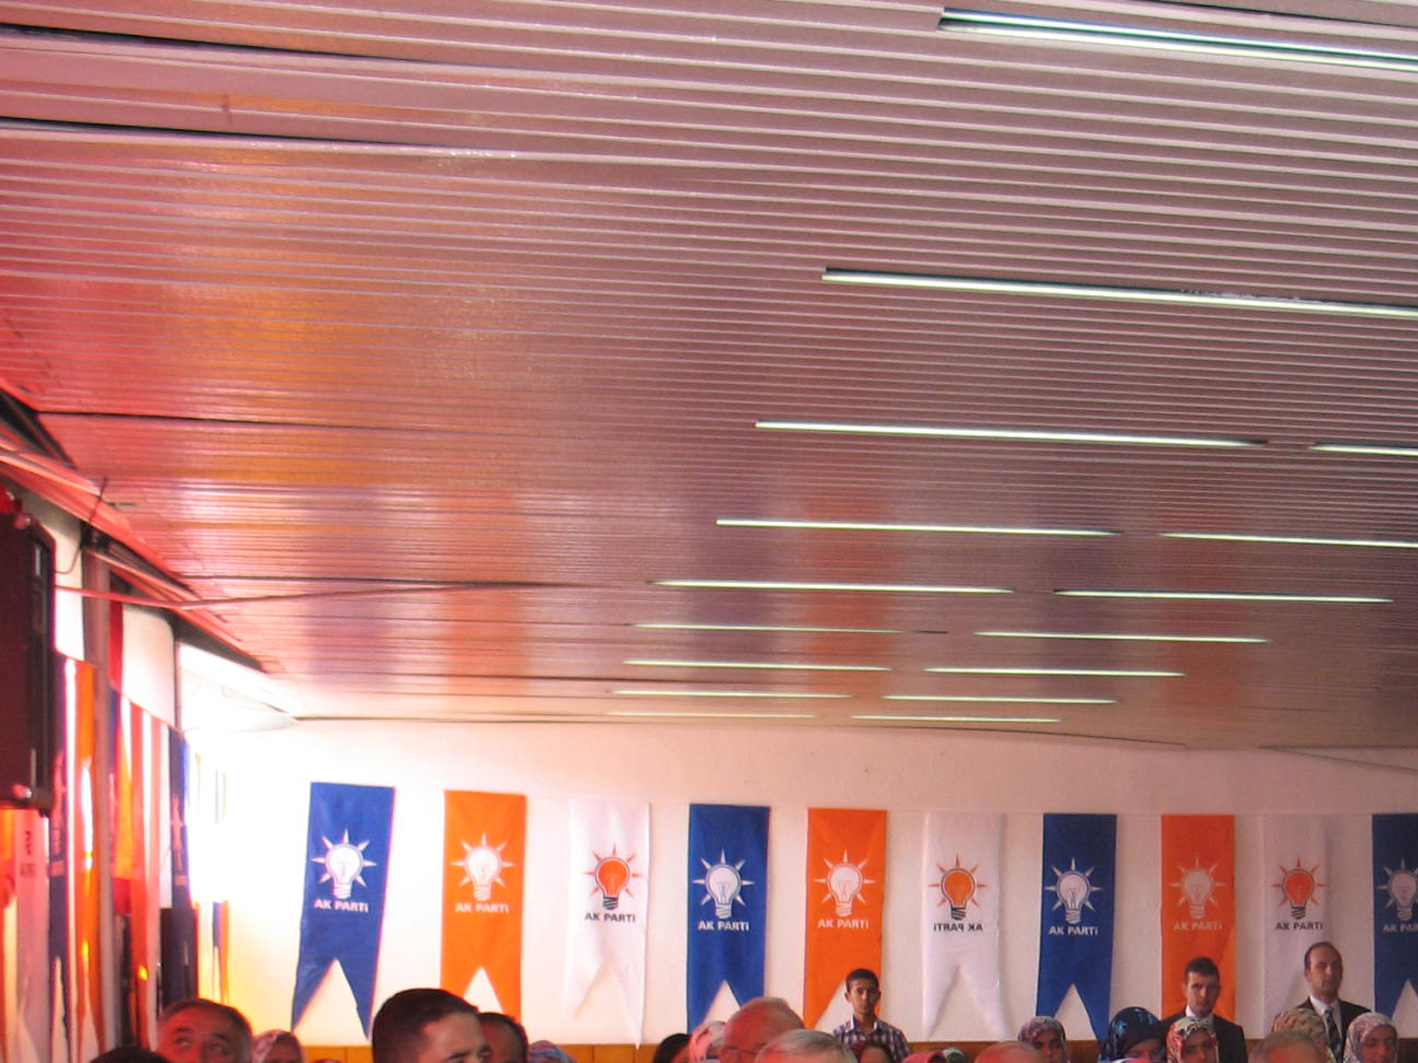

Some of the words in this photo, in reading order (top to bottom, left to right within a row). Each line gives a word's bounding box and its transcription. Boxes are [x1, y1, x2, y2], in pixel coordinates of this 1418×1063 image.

[314, 899, 332, 910] AK
[455, 902, 472, 913] AK
[584, 912, 600, 922] AK
[698, 920, 715, 931] AK
[817, 918, 834, 928] AK
[1173, 921, 1188, 931] AK
[1275, 921, 1290, 931] AK
[1382, 923, 1397, 933] AK
[1049, 925, 1065, 935] AK
